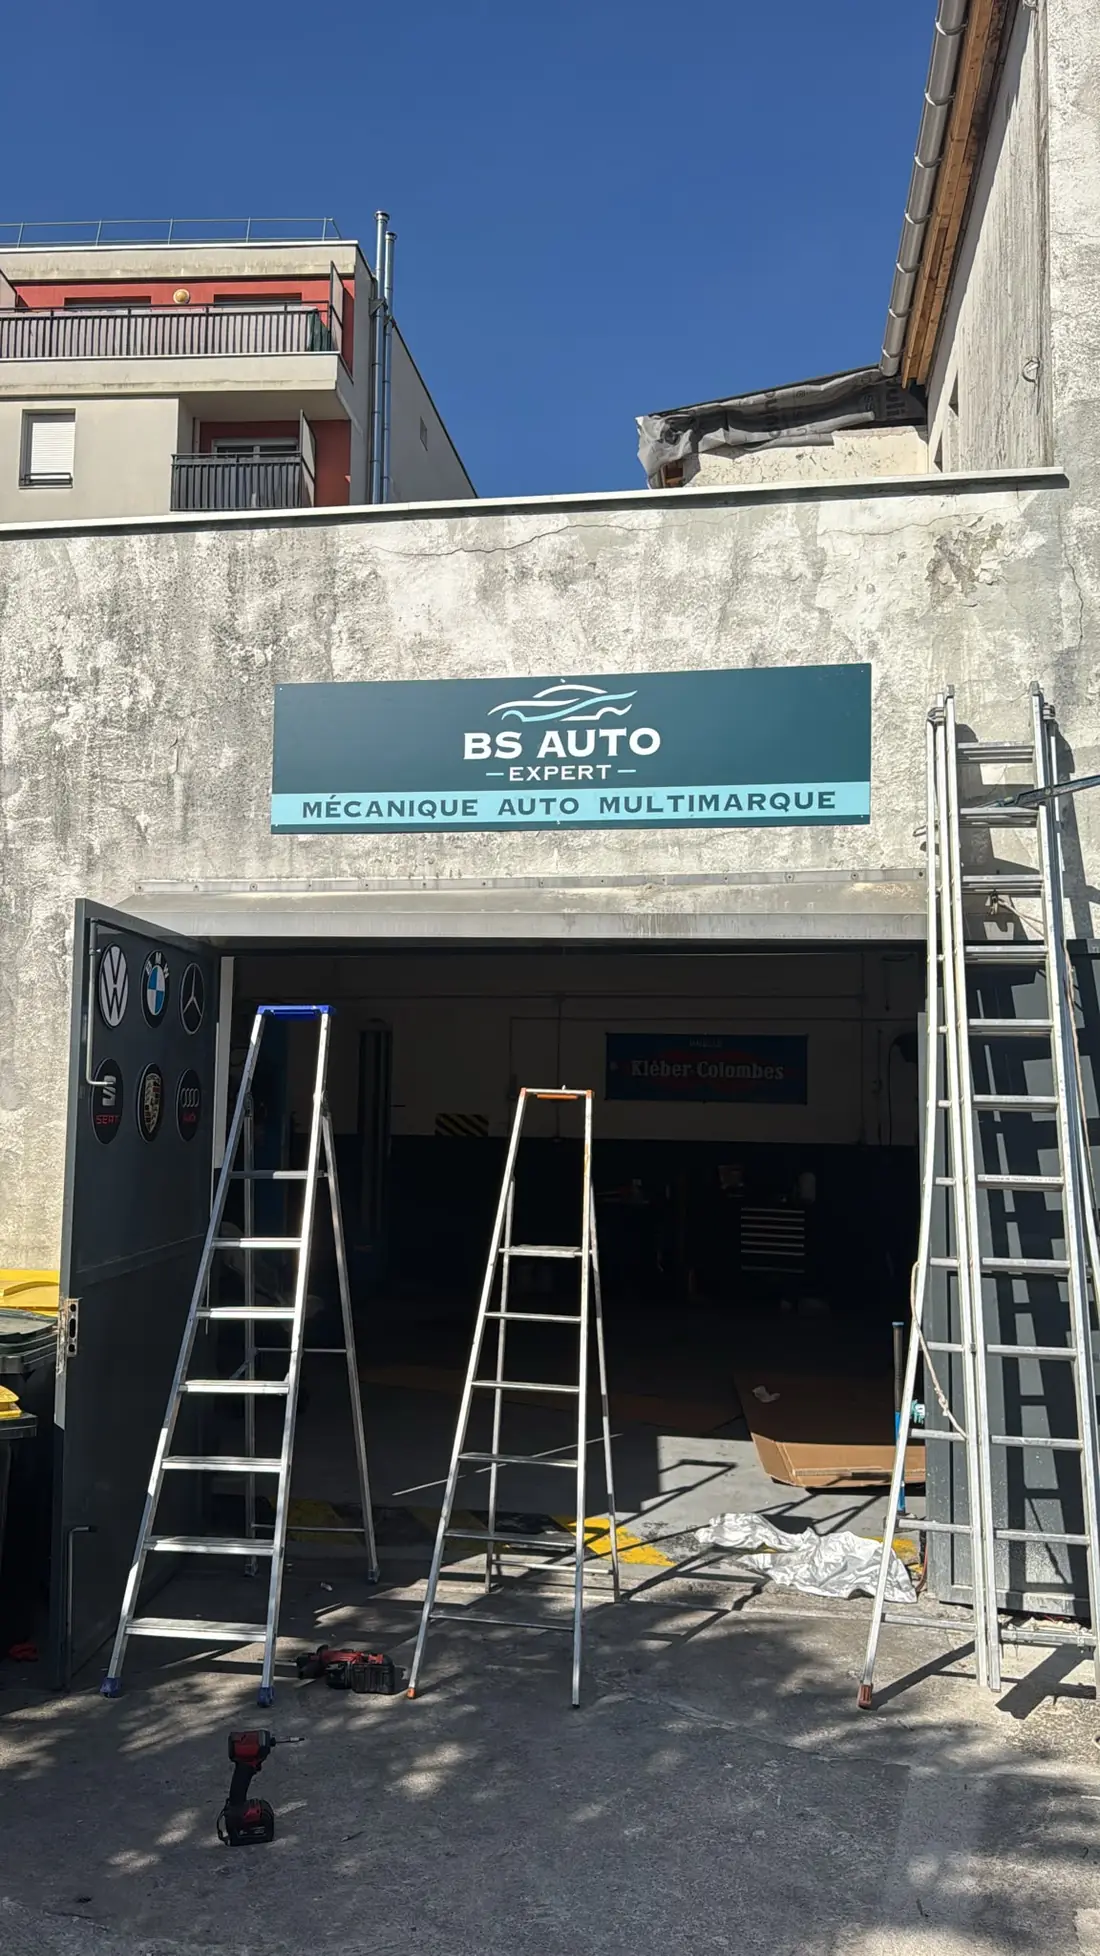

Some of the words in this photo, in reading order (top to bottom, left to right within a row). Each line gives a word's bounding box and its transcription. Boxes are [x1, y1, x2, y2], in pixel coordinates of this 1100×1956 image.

[463, 731, 523, 760] BS
[536, 727, 661, 758] AUTO
[509, 764, 612, 782] EXPERT
[302, 795, 479, 819] MÉCANIQUE
[497, 797, 580, 817] AUTO
[599, 791, 836, 814] MULTIMARQUE
